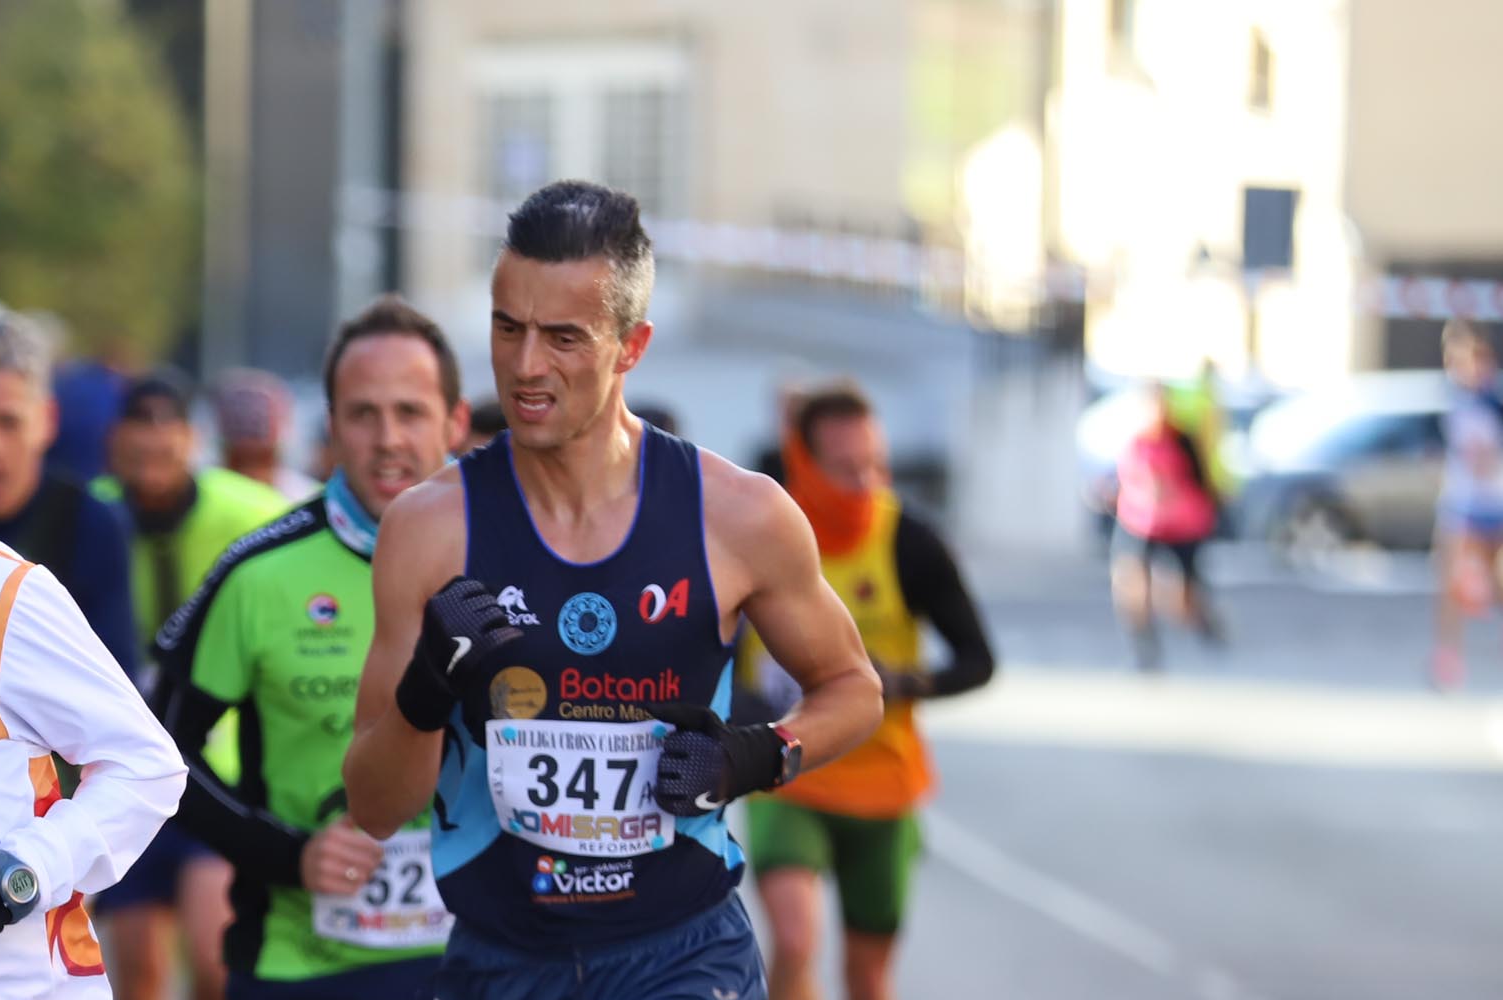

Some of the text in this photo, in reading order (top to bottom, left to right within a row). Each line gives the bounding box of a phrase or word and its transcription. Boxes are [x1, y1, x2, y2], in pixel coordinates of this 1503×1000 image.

[560, 667, 681, 702] Botanik
[558, 701, 614, 720] Centro
[528, 754, 638, 811] 347
[365, 861, 424, 906] 52
[552, 869, 635, 894] Victor
